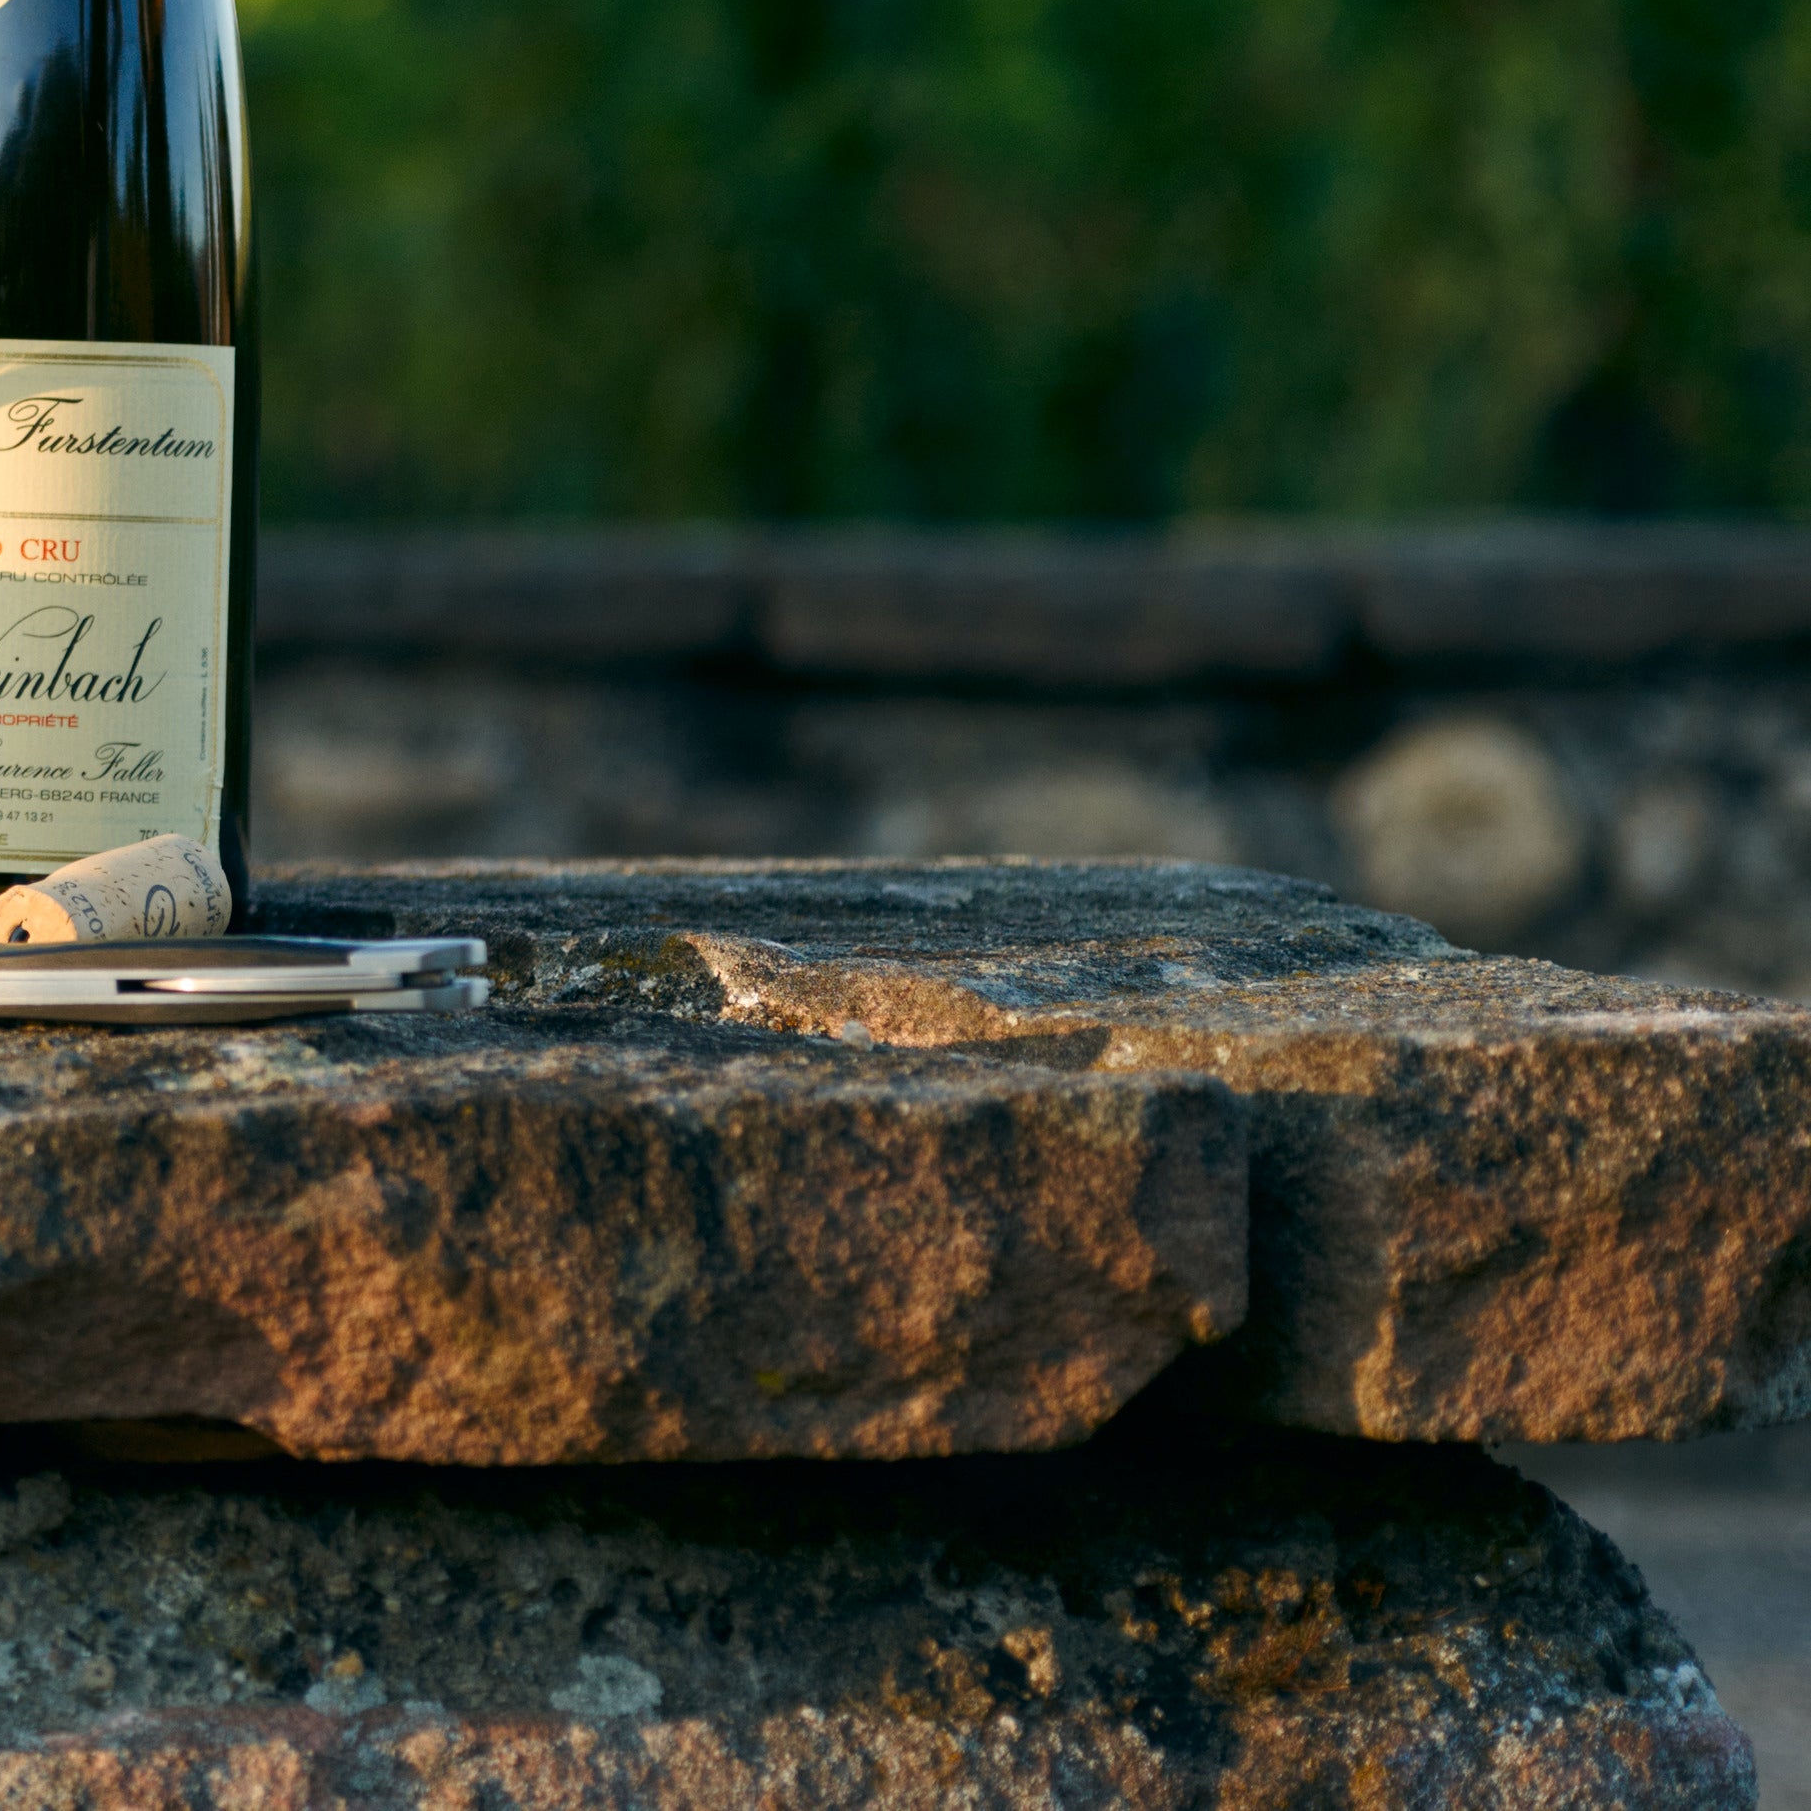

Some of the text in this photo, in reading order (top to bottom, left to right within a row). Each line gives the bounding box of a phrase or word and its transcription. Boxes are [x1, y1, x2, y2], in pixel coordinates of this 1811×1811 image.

[20, 538, 82, 562] CRU
[34, 572, 149, 587] CONTRÔLÉE
[81, 742, 166, 782] Faller
[100, 791, 160, 804] FRANCE
[7, 811, 20, 821] 47
[25, 811, 38, 822] 13
[40, 812, 54, 823] 21
